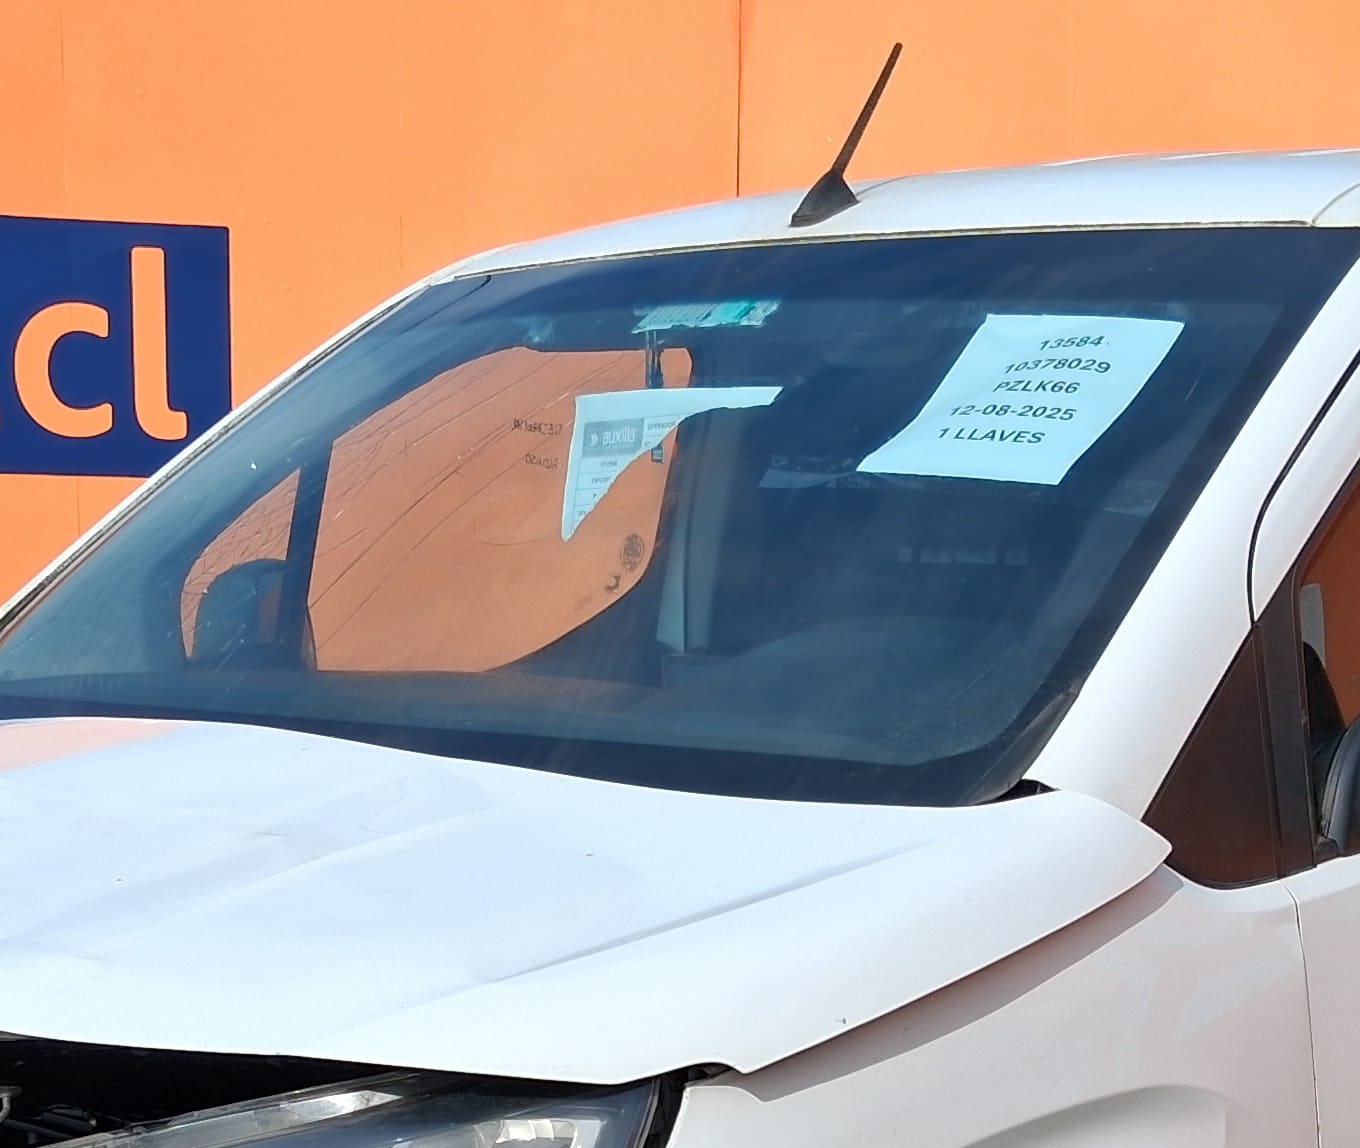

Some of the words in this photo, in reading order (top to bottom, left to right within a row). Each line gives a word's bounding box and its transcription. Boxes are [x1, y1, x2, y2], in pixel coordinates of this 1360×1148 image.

[1039, 334, 1106, 351] 13584
[1003, 356, 1113, 374] 10378029
[991, 378, 1082, 394] PZLK66
[949, 403, 1079, 421] 12-08-2025
[938, 426, 951, 440] 1
[952, 426, 1047, 444] LLAVES
